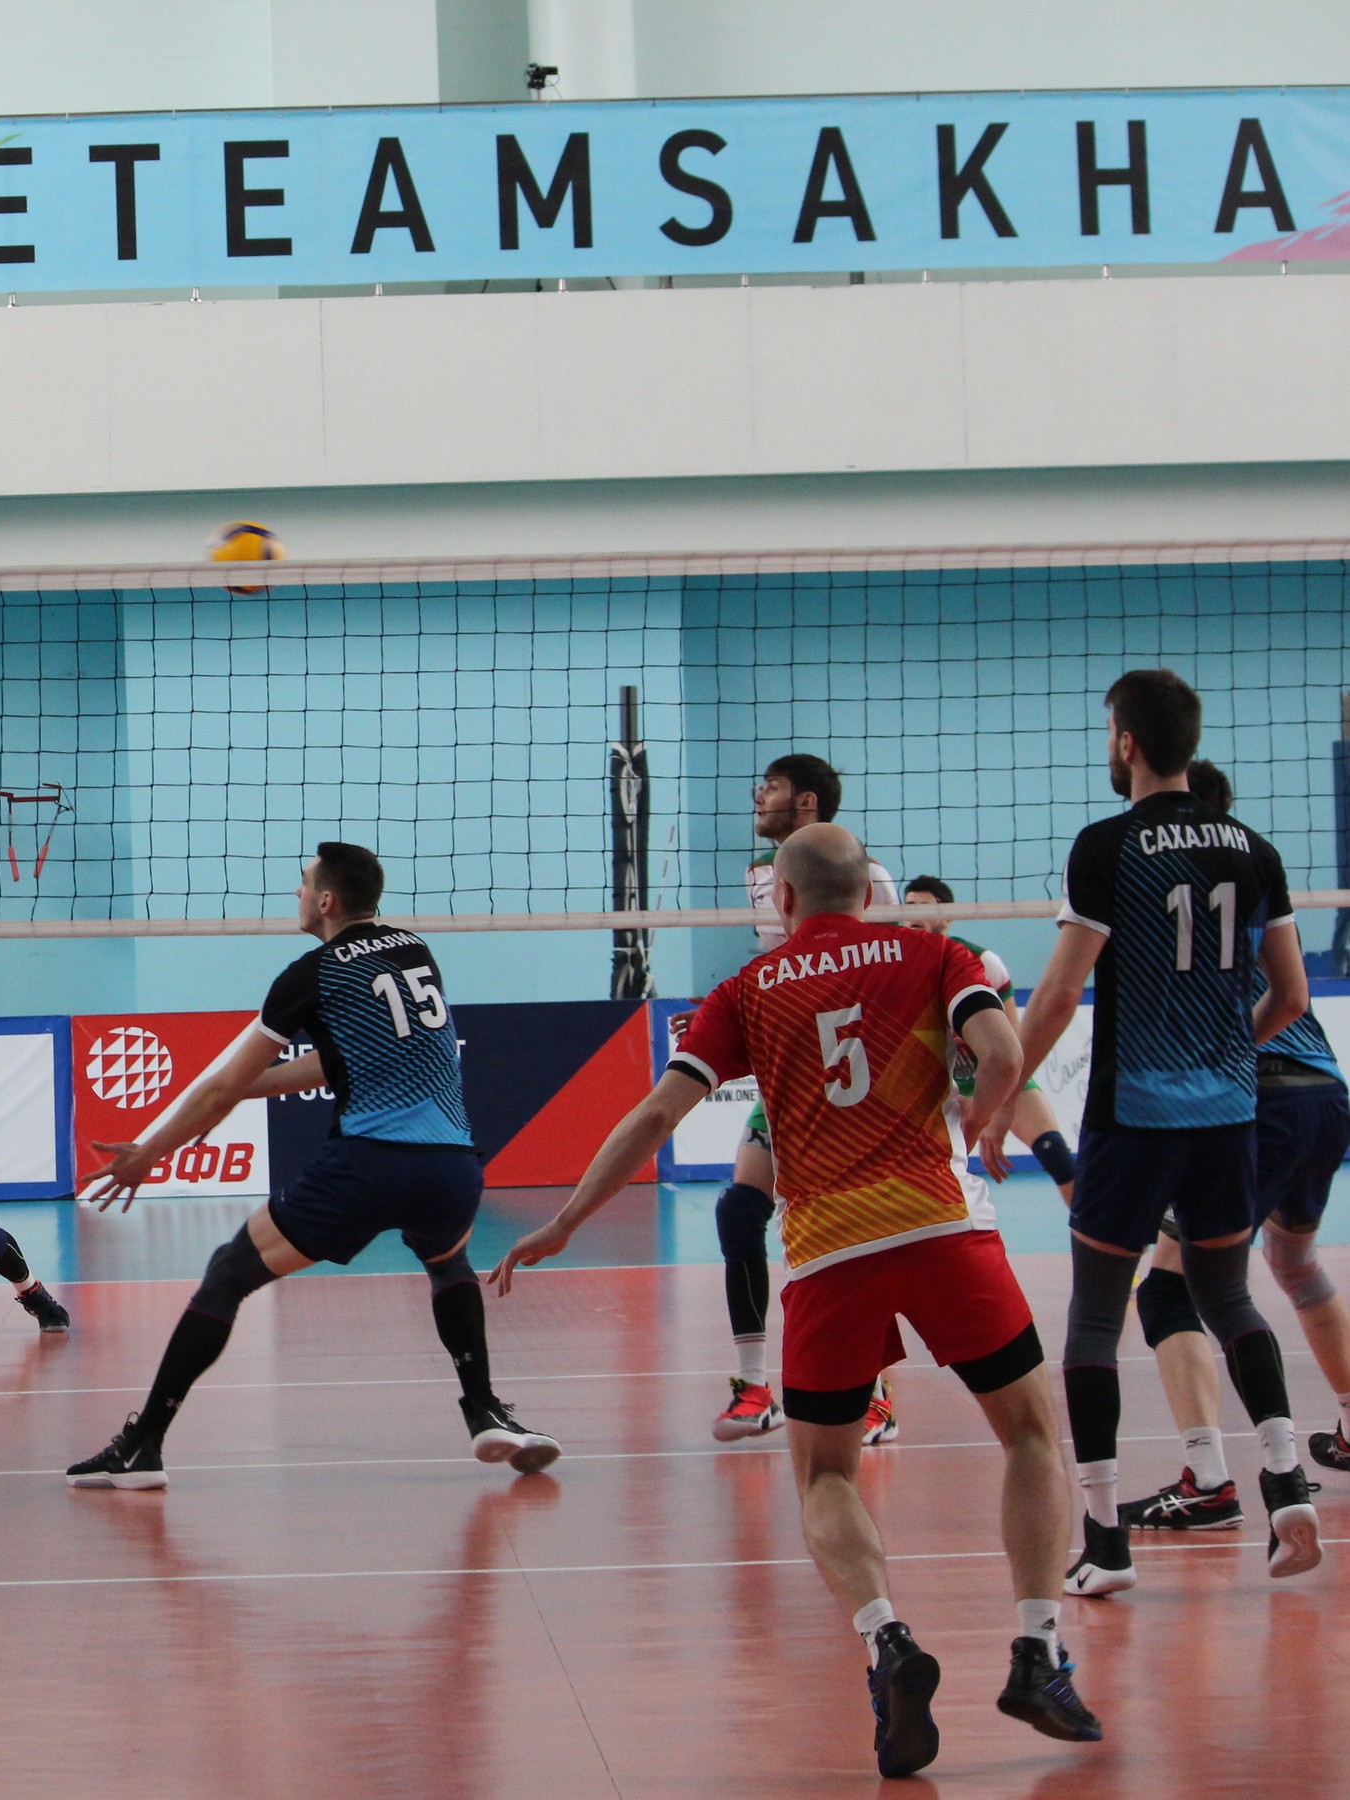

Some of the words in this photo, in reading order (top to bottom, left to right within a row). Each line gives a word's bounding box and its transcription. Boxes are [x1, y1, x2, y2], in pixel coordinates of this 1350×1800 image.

[1139, 823, 1251, 855] САХАЛИН
[334, 931, 426, 963] САХАЛИН
[1167, 882, 1236, 971] 11
[757, 938, 903, 991] САХАЛИН
[371, 965, 447, 1039] 15
[815, 1003, 871, 1108] 5
